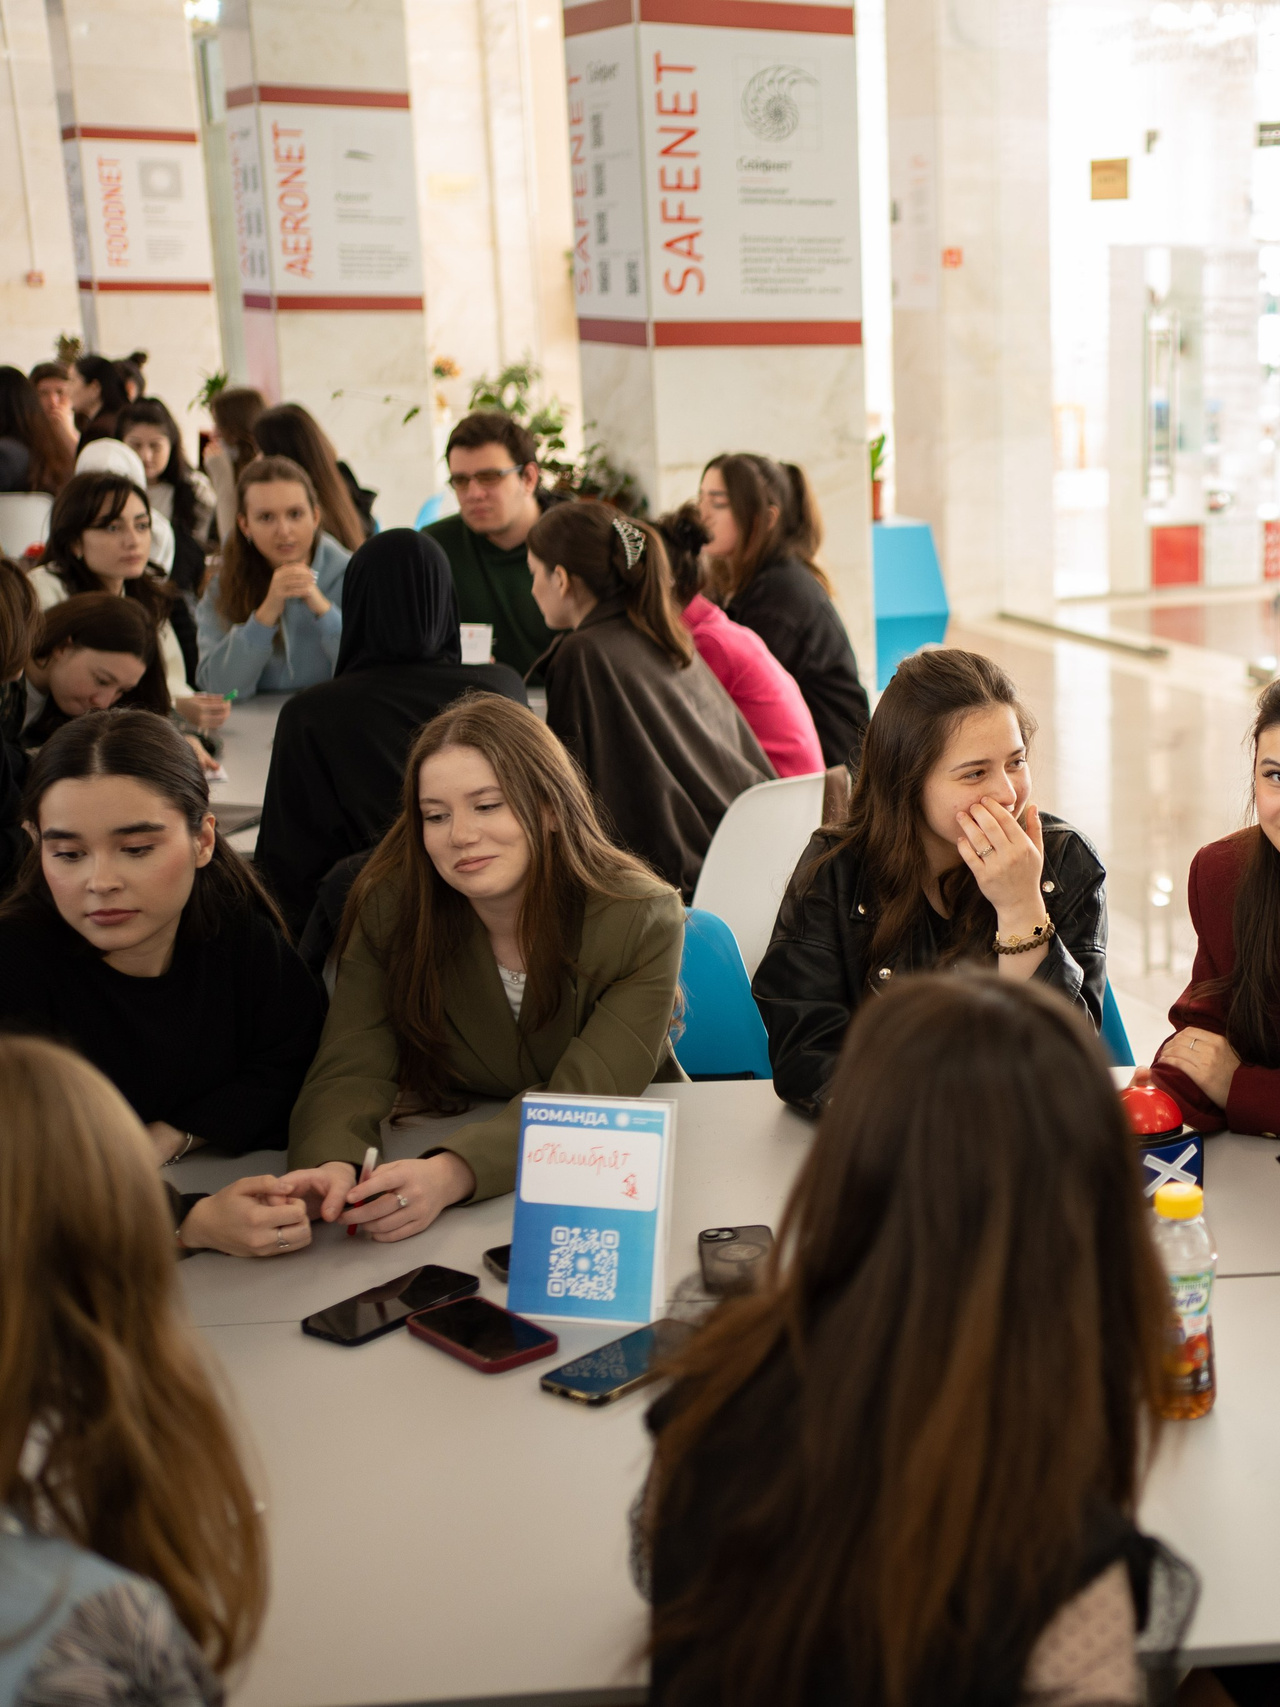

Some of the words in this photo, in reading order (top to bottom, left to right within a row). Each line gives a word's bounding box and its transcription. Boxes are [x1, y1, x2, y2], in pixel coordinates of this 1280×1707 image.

[96, 155, 131, 269] FOODNET
[271, 119, 315, 281] AERONET
[653, 51, 706, 297] SAFENET
[526, 1107, 610, 1127] КОМАНДА
